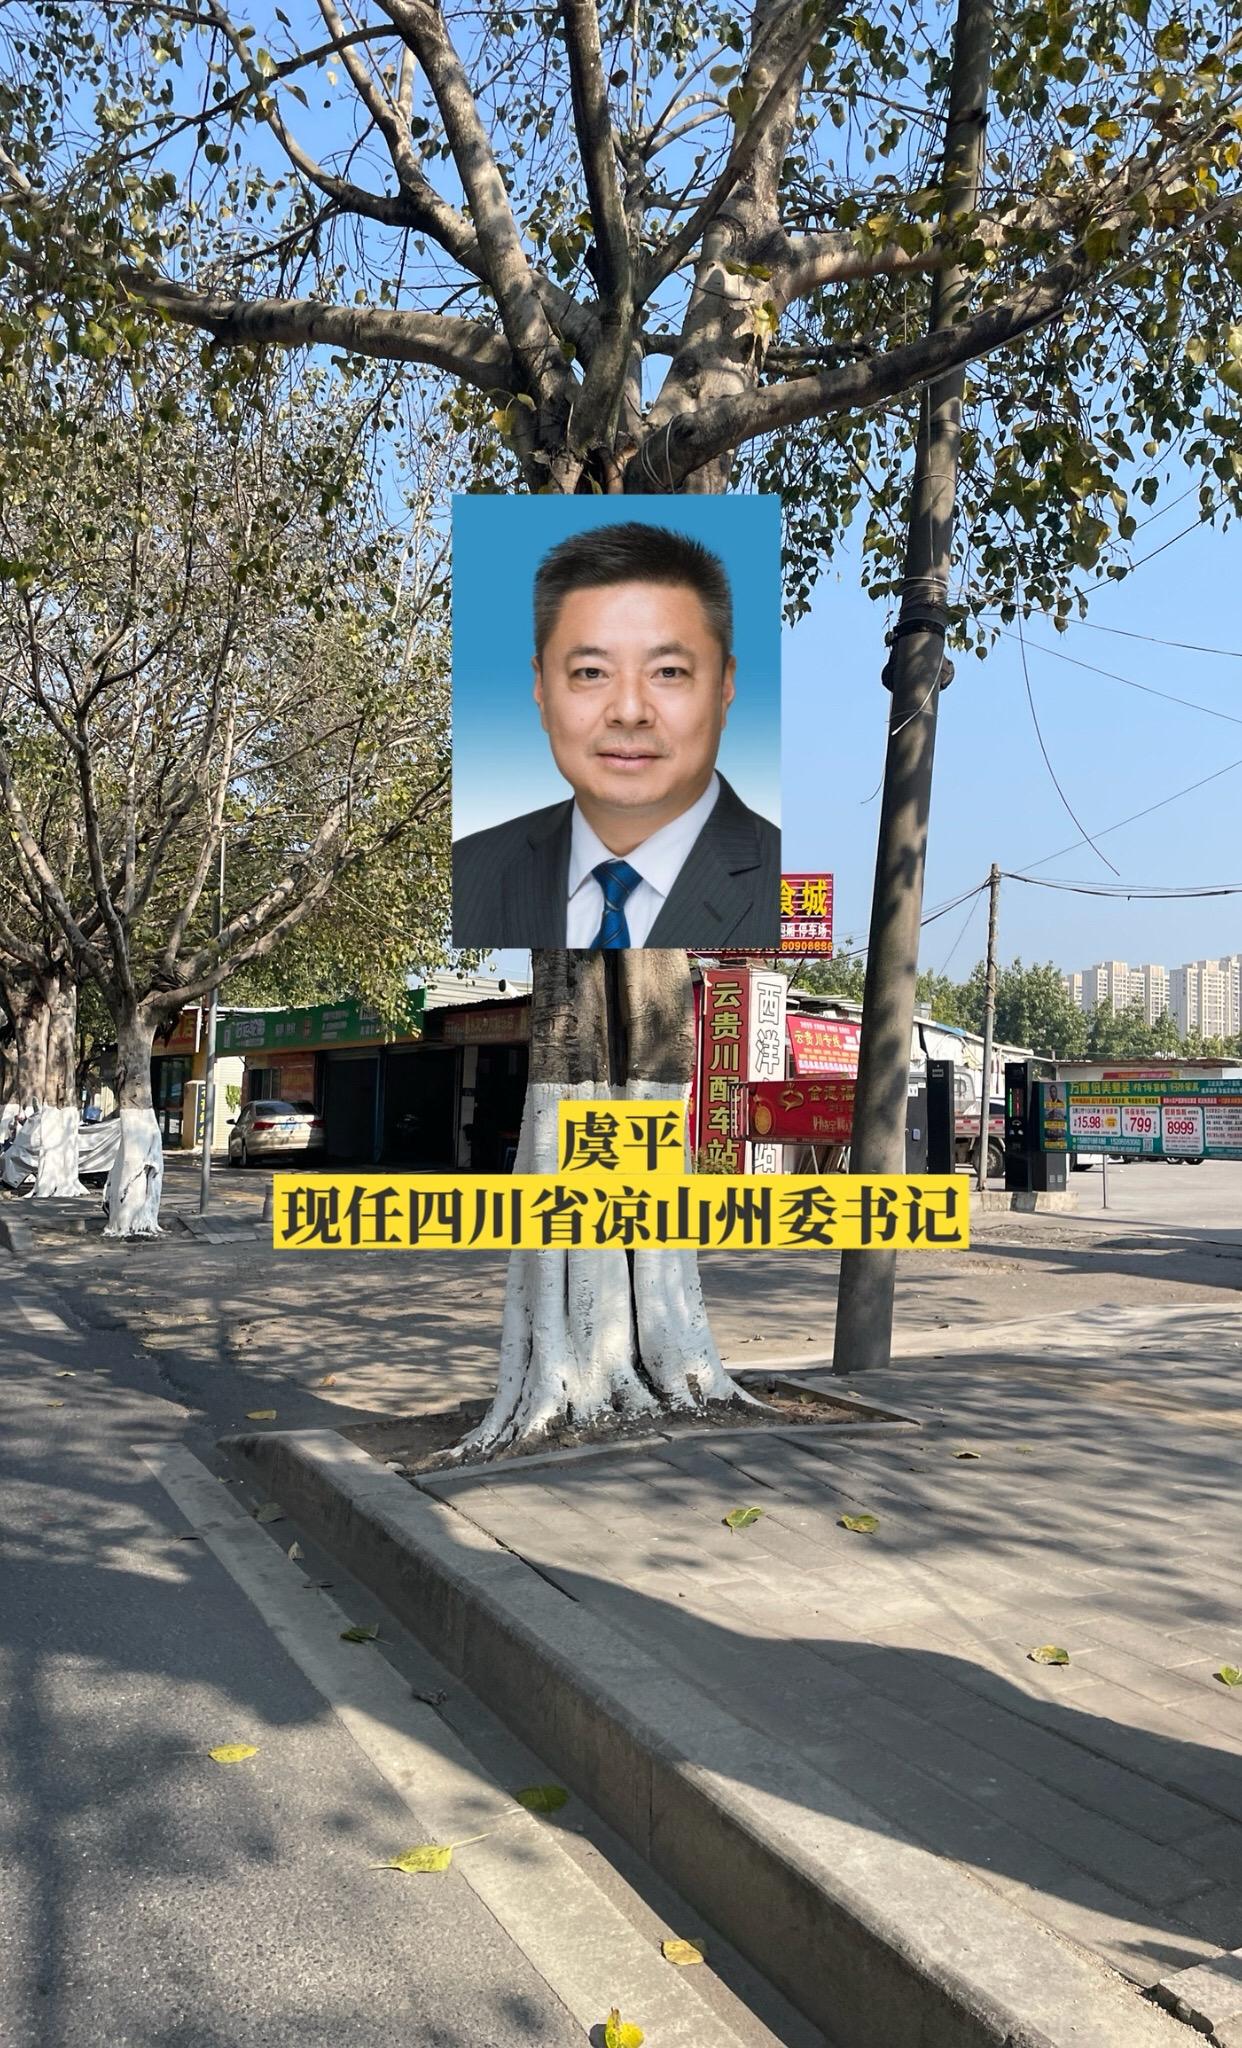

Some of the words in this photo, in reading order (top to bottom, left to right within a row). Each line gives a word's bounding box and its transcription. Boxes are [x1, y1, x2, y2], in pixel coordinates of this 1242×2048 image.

[708, 981, 743, 1172] 云贵川配车站
[753, 981, 782, 1174] 西洋站
[1077, 1116, 1101, 1129] 15.98
[1130, 1117, 1151, 1133] 799
[1167, 1121, 1195, 1135] 8999
